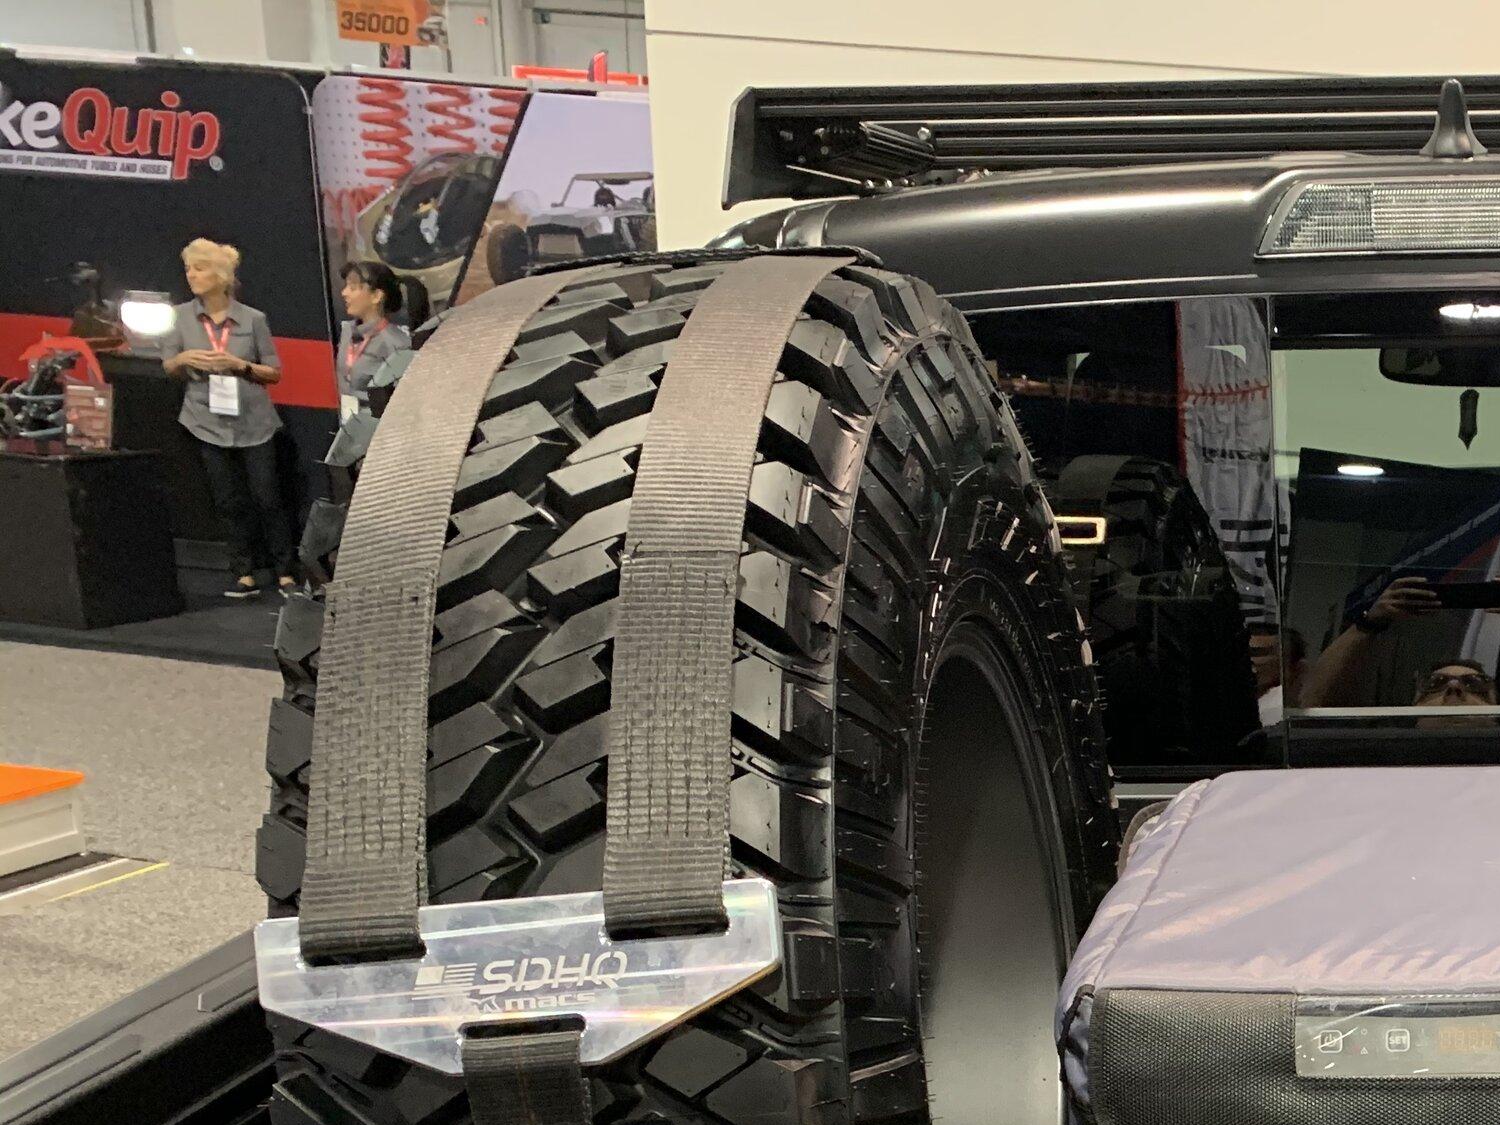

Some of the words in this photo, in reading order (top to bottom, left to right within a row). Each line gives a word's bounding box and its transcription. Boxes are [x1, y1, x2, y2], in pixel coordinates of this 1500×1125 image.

[340, 10, 410, 36] 35000
[479, 951, 628, 995] SDHQ
[1388, 1035, 1408, 1045] SET
